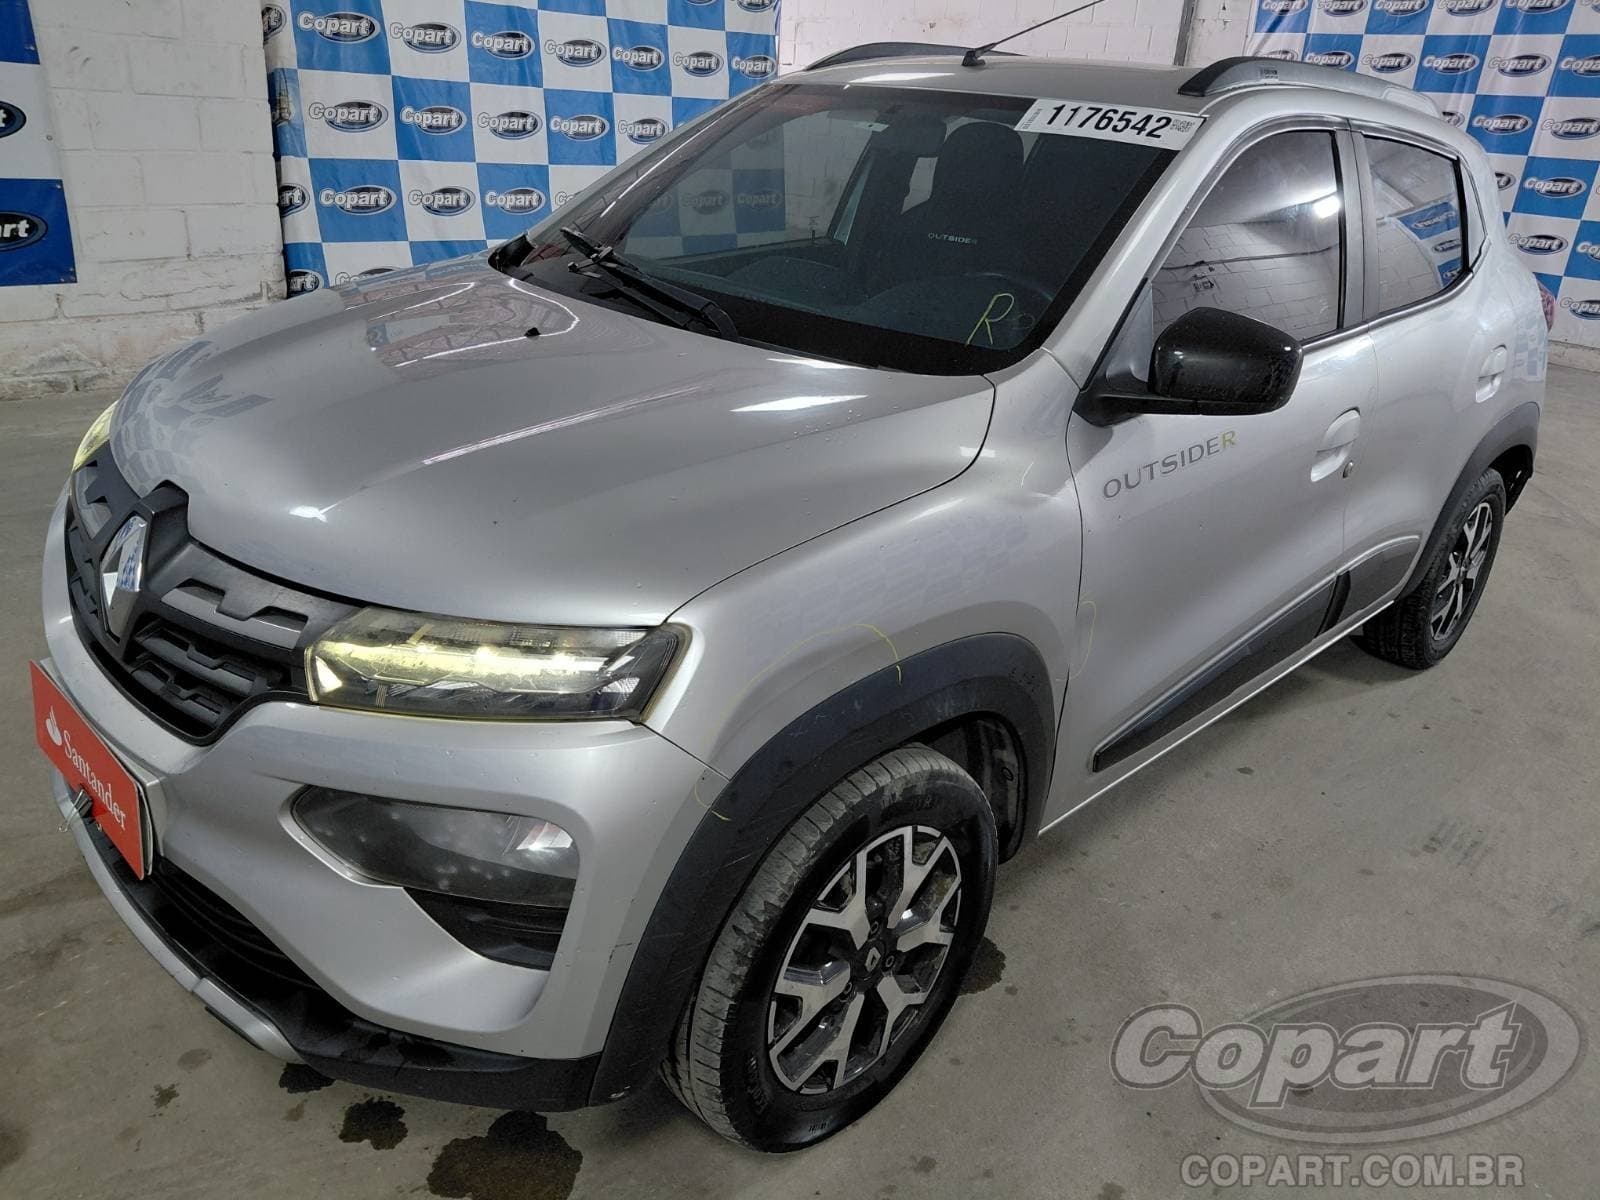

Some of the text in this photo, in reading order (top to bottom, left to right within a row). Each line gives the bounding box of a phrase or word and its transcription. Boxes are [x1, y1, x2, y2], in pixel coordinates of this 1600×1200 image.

[299, 11, 370, 36] Copart
[390, 22, 452, 45] Copart
[472, 32, 529, 52] Copart
[545, 40, 599, 60] Copart
[614, 47, 659, 66] Copart
[1306, 53, 1348, 66] Copart
[673, 53, 717, 71] Copart
[732, 57, 772, 73] Copart
[1361, 54, 1409, 68] Copart
[1423, 55, 1475, 70] Copart
[1489, 57, 1543, 72] Copart
[1560, 57, 1600, 73] Copa
[309, 102, 378, 121] Copart
[401, 106, 458, 127] Copart
[478, 112, 535, 132] Copart
[550, 116, 602, 135] Copart
[617, 120, 663, 137] Copart
[1046, 104, 1172, 139] 1176542
[1472, 116, 1525, 131] Copart
[1541, 119, 1600, 135] Copart
[1524, 177, 1578, 194] Copart
[320, 188, 388, 210] Copart
[408, 189, 466, 209] Copart
[485, 191, 538, 209] Copart
[1510, 234, 1561, 250] Copart
[965, 293, 1014, 347] R
[1103, 430, 1236, 498] OUTSIDER
[63, 730, 126, 831] Santander
